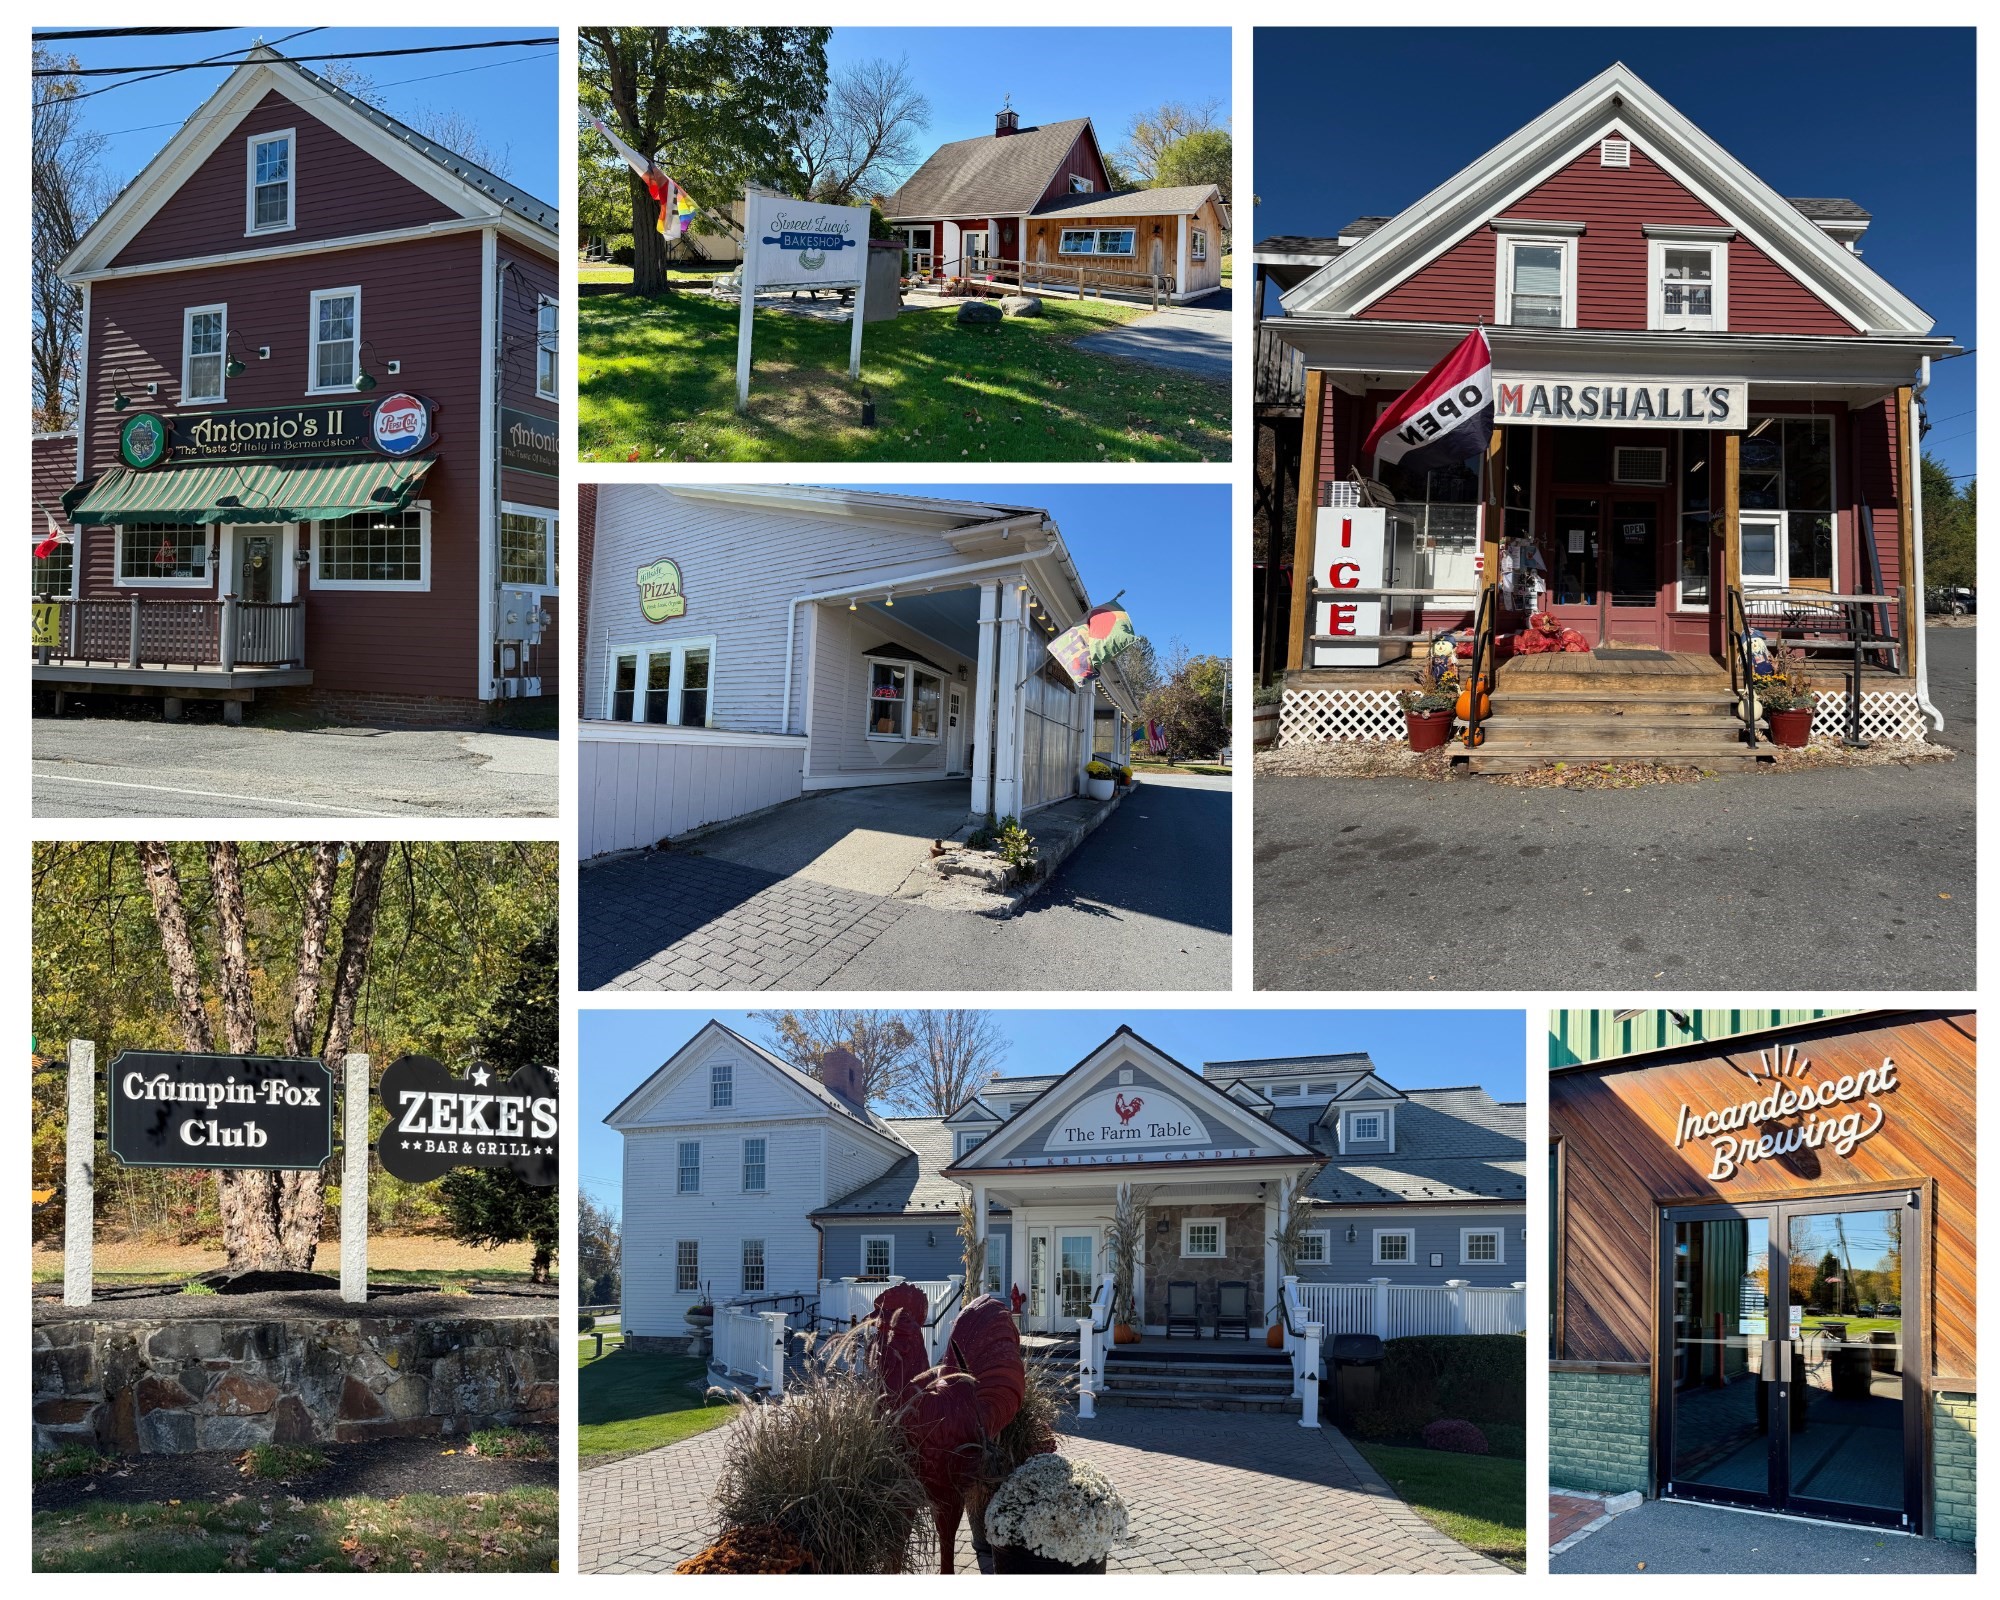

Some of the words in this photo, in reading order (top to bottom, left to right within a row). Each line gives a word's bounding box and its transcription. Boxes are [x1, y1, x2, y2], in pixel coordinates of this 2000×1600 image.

[770, 212, 814, 232] Sweet
[815, 216, 851, 235] Lucy's
[784, 235, 841, 248] BAKESHOP
[1496, 383, 1730, 423] MARSHALL'S
[191, 413, 318, 447] Antonio's
[328, 410, 343, 435] II
[201, 444, 227, 454] Taste
[230, 442, 242, 454] Of
[244, 442, 267, 452] Italy
[271, 441, 280, 450] in
[1624, 523, 1644, 535] OPEN
[1329, 512, 1361, 636] ICE
[873, 688, 898, 698] OPEN
[122, 1072, 321, 1109] Crumpin-Fox
[1675, 1056, 1898, 1147] Incandescent
[398, 1090, 558, 1139] ZEKE'S
[180, 1119, 268, 1148] Club
[1065, 1127, 1095, 1142] The
[1101, 1126, 1141, 1140] Farm
[1147, 1121, 1192, 1138] Table
[1708, 1103, 1883, 1181] Brewing
[425, 1139, 458, 1153] BAR
[462, 1141, 473, 1155] &
[477, 1142, 531, 1156] GRILL
[1007, 1159, 1028, 1167] AT
[1047, 1153, 1144, 1165] KRINGLE
[1165, 1149, 1256, 1161] CANDLE
